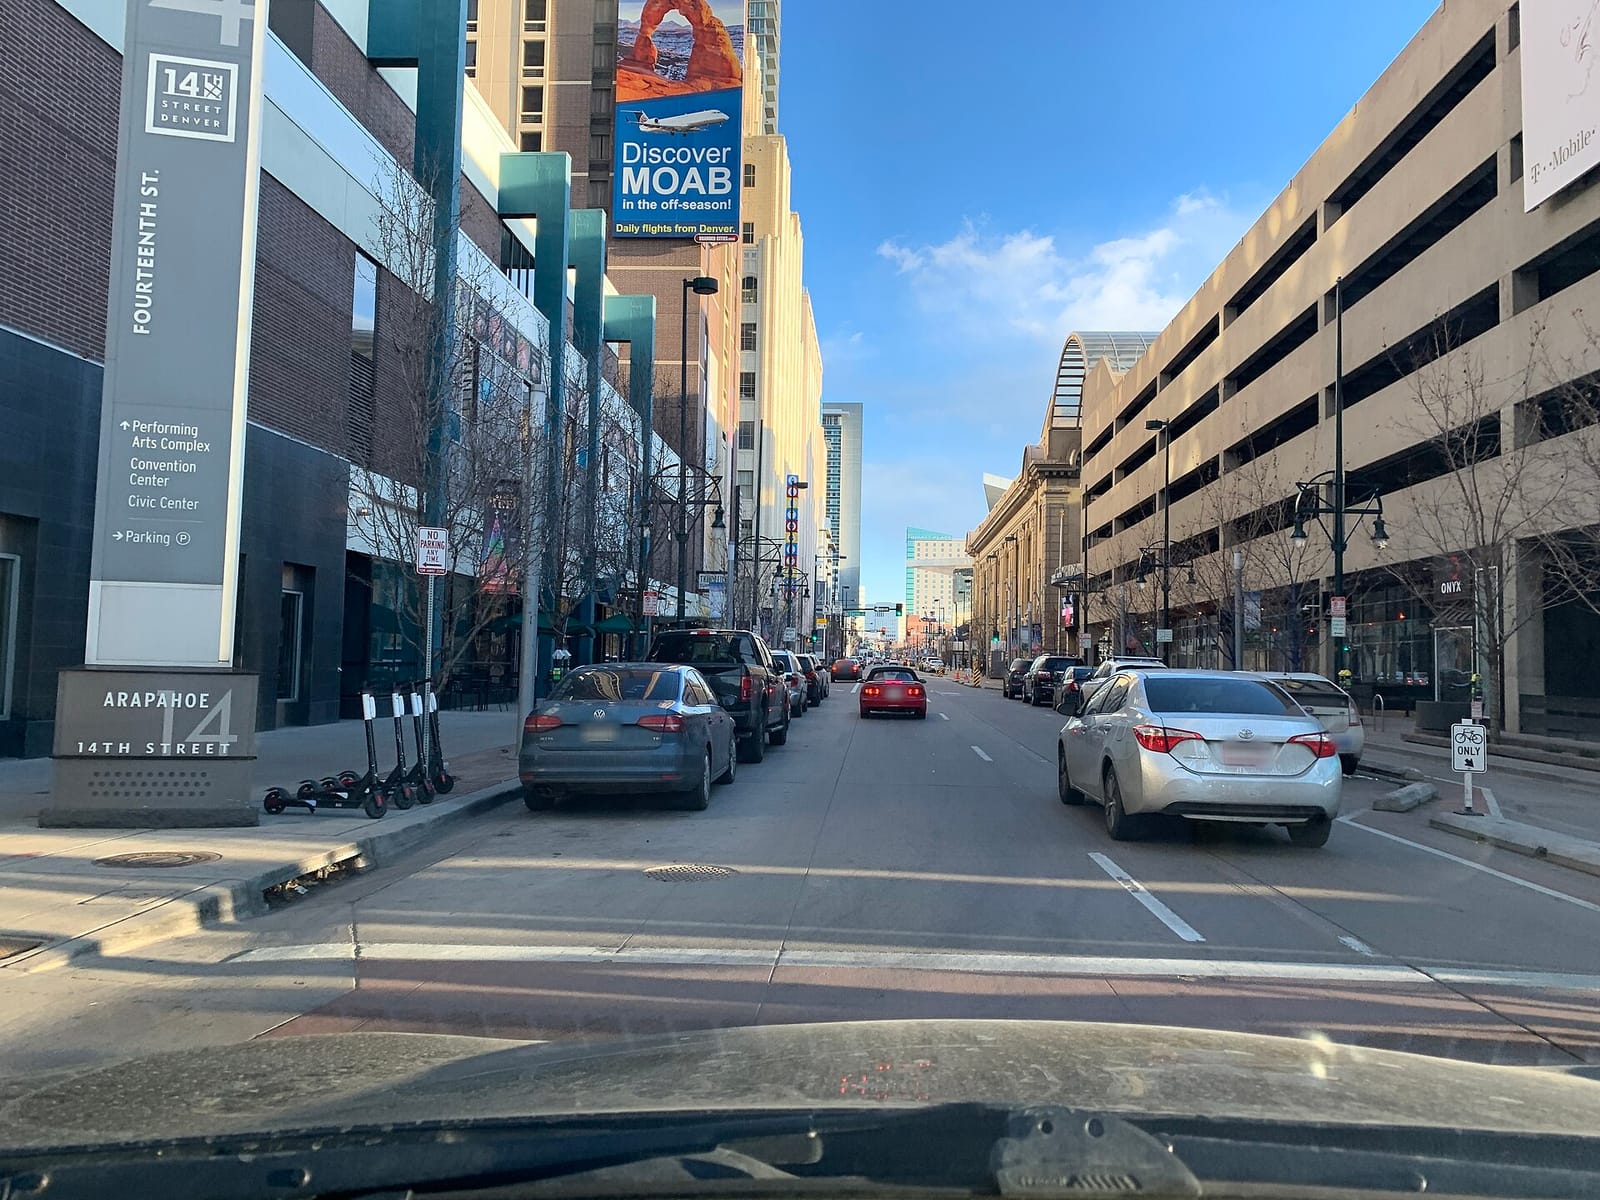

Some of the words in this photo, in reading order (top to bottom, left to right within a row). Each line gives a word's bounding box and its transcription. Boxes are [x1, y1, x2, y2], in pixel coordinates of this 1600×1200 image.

[161, 100, 222, 114] STREET
[161, 114, 221, 128] DENVER
[623, 142, 731, 164] Discover
[141, 169, 161, 197] ST.
[622, 167, 732, 195] MOAB
[622, 199, 635, 210] in
[637, 199, 658, 210] the
[661, 199, 731, 210] off-season!
[616, 224, 640, 234] Daily
[642, 224, 672, 234] flights
[674, 224, 697, 233] from
[699, 224, 735, 233] Denver.
[133, 203, 157, 335] FOURTEENTH
[132, 420, 198, 439] Performing
[132, 437, 157, 449] Arts
[160, 438, 210, 453] Complex
[130, 458, 196, 472] Convention
[129, 473, 169, 487] Center
[128, 495, 156, 508] Civic
[160, 496, 199, 510] Center
[125, 530, 170, 546] Parking
[427, 531, 438, 539] NO
[420, 540, 445, 550] PARKING
[1441, 581, 1462, 594] ONYX
[103, 691, 210, 709] ARAPAHOE
[77, 742, 130, 754] 14TH
[146, 743, 230, 754] STREET
[1457, 747, 1481, 756] ONLY
